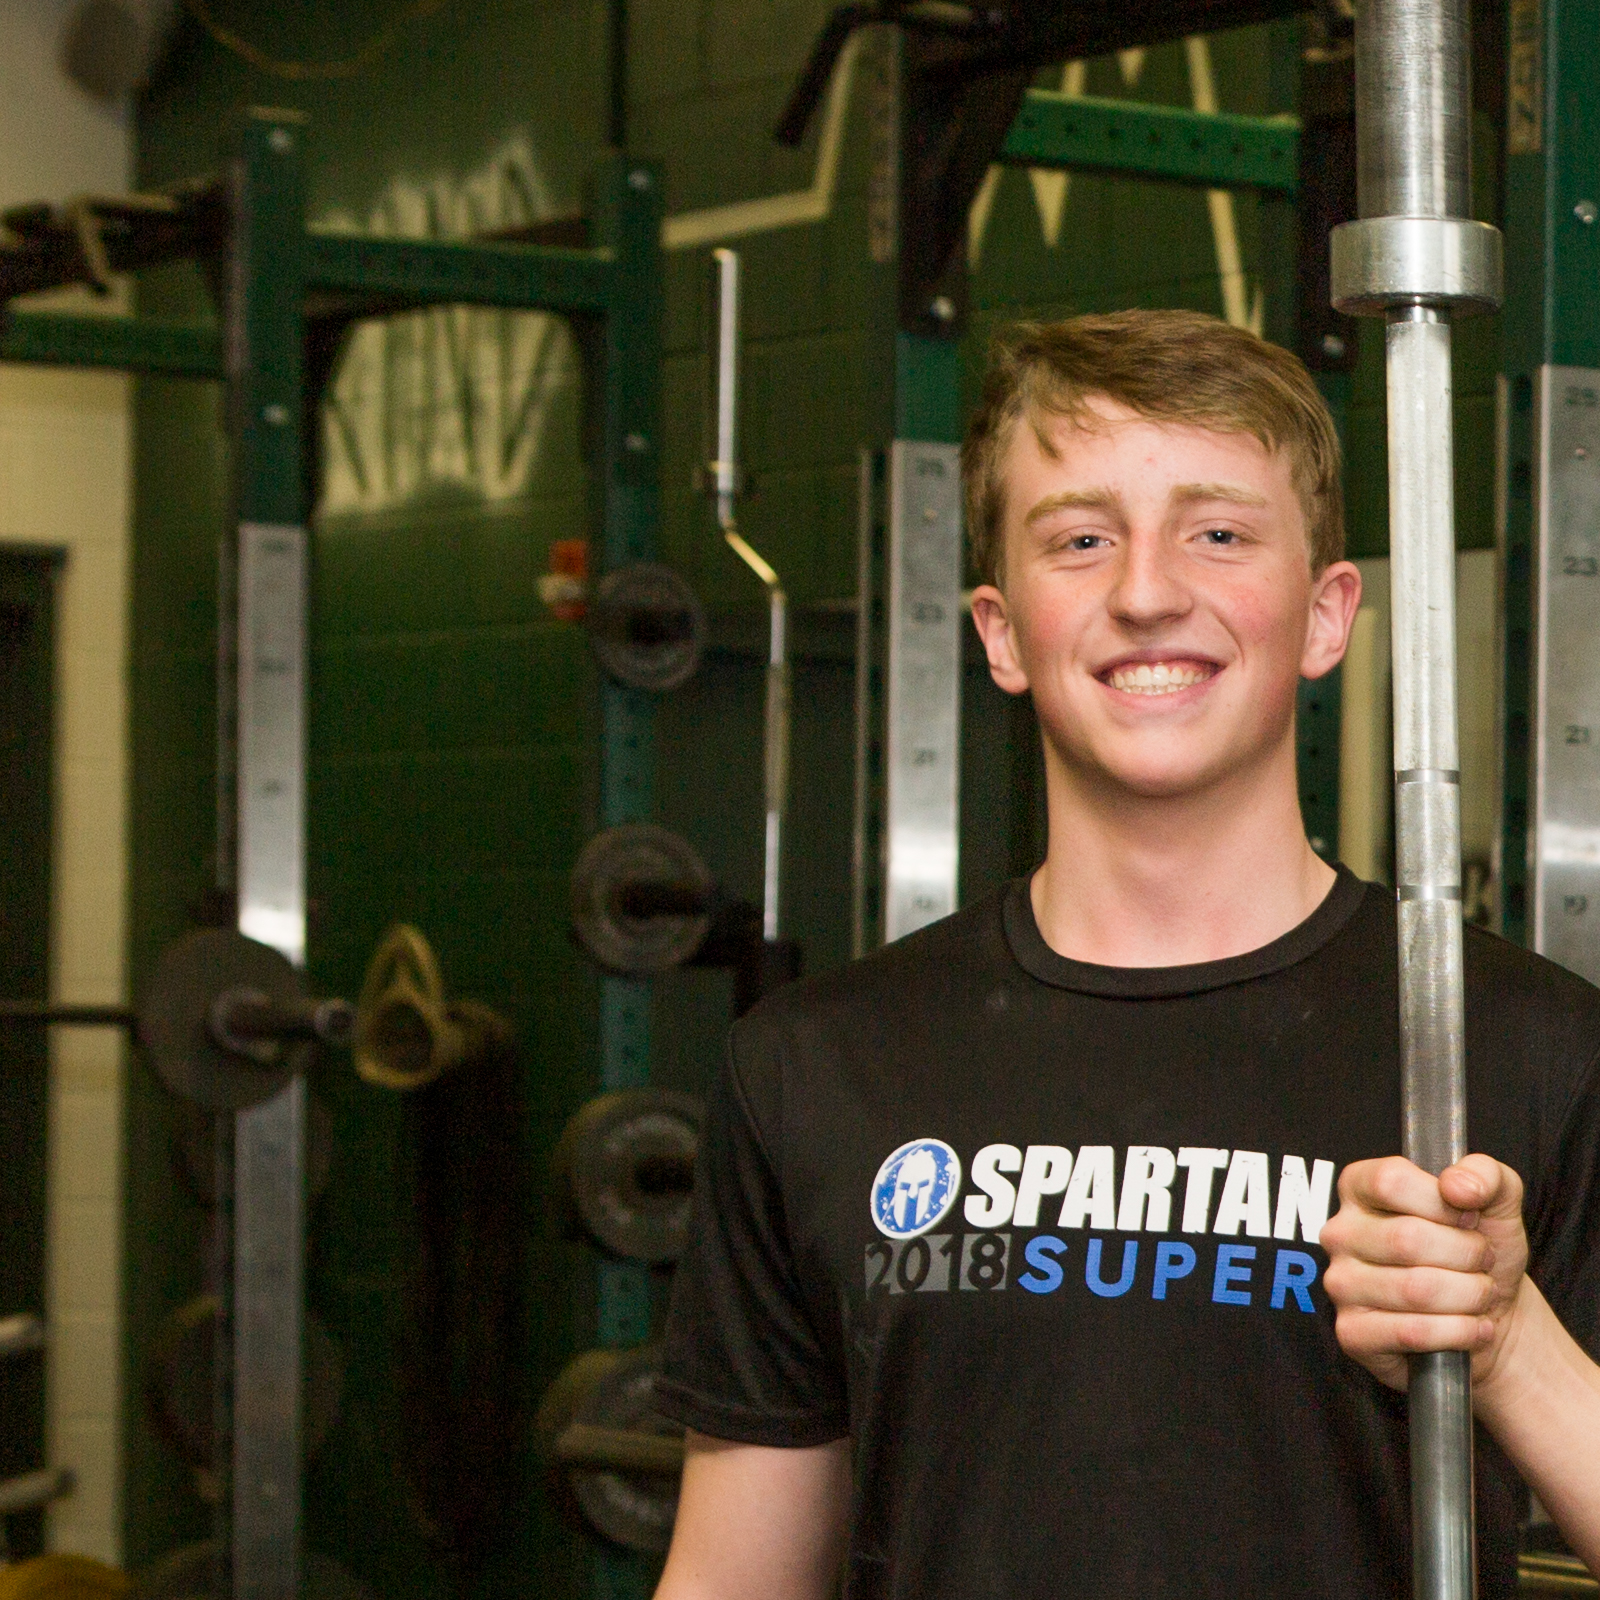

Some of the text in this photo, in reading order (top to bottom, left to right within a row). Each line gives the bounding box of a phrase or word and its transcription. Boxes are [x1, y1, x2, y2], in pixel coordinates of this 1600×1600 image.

[1562, 555, 1599, 577] 23
[963, 1142, 1335, 1244] SPARTAN
[866, 1233, 1318, 1315] 2018 SUPER
